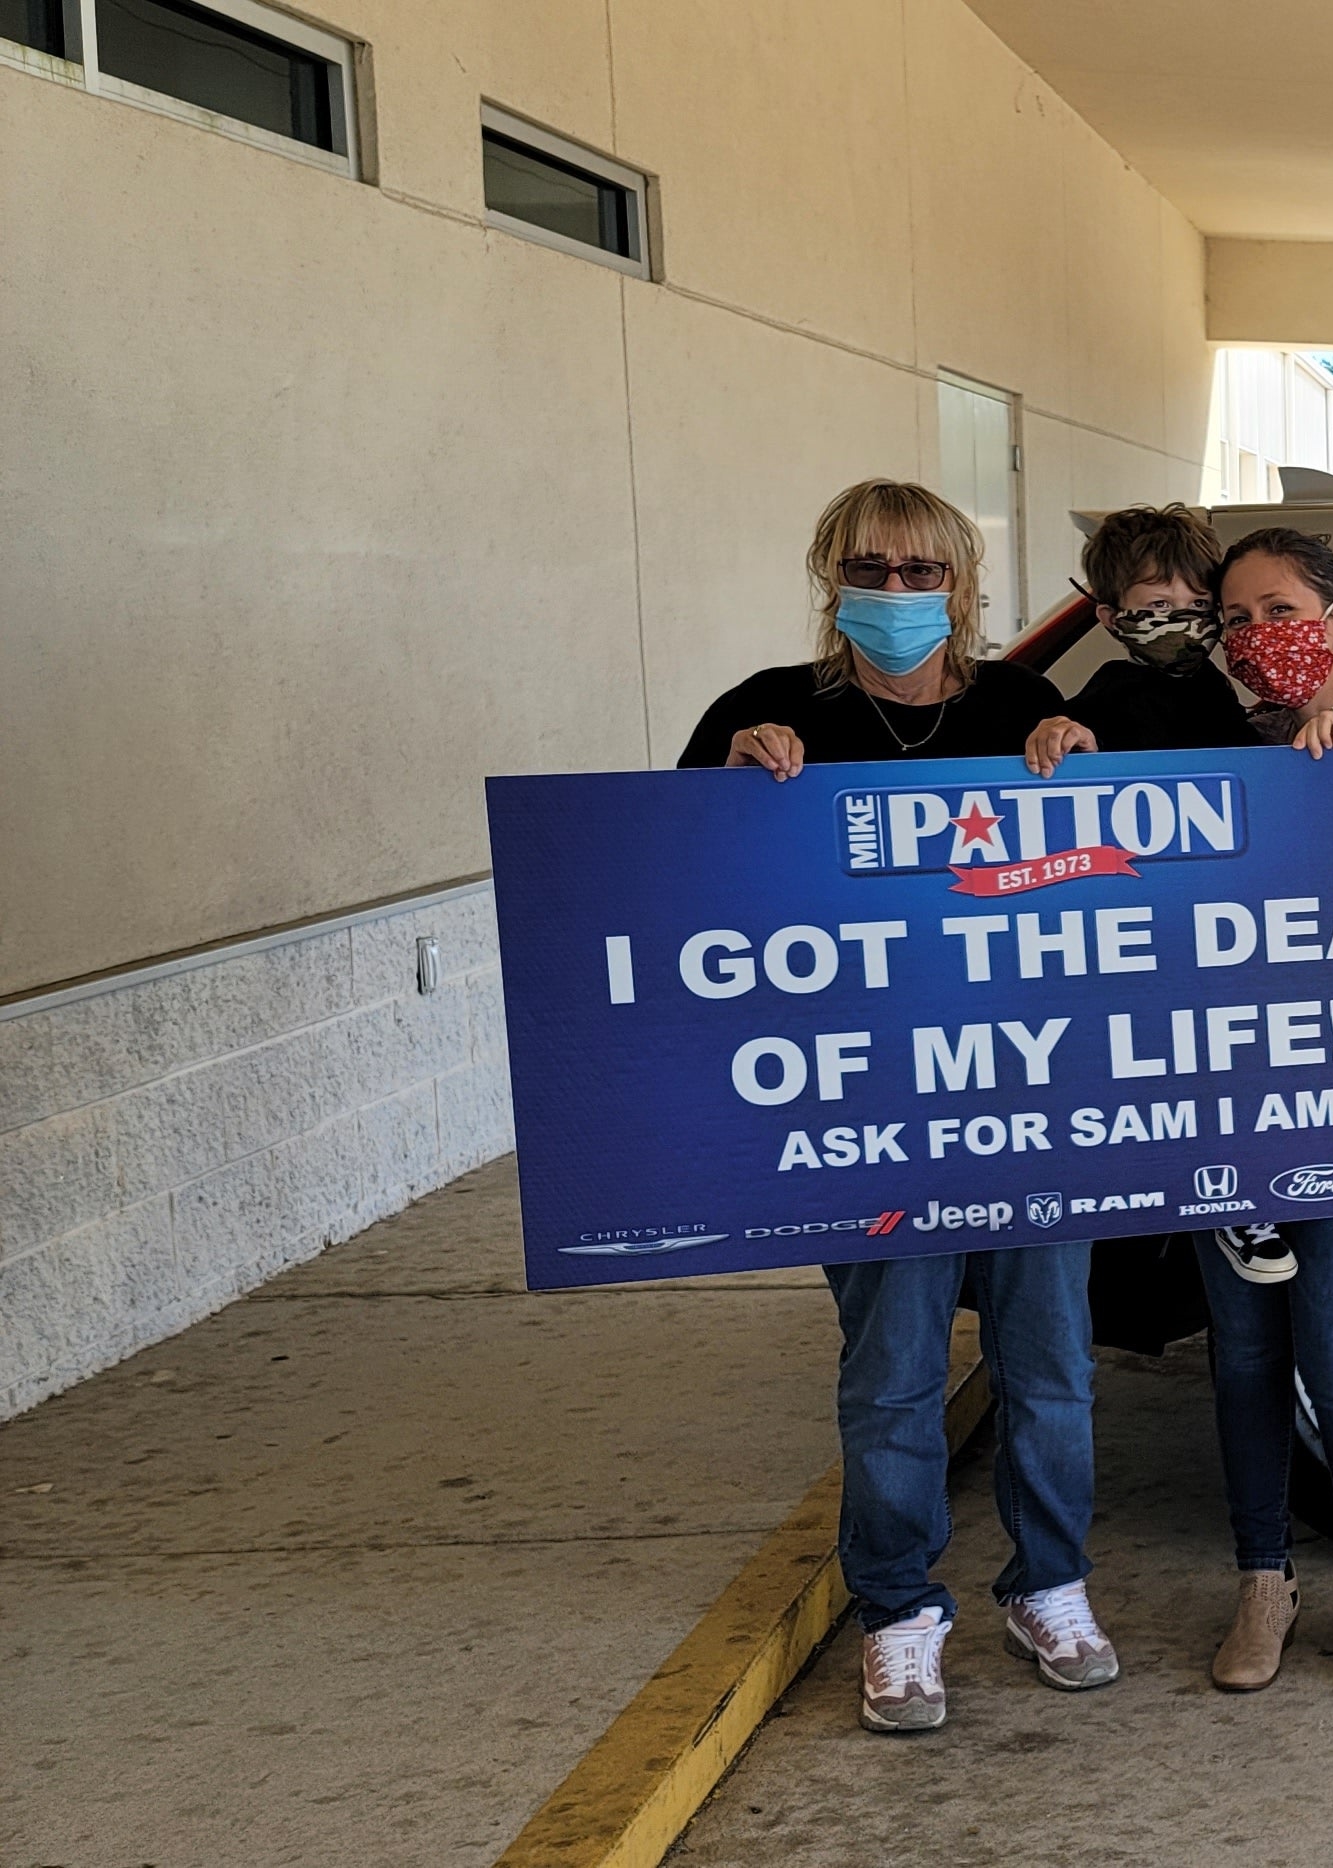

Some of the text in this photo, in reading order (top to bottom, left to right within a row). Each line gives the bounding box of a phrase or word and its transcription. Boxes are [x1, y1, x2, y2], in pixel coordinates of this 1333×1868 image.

[846, 795, 877, 869] MIKE
[887, 780, 1234, 867] PATTON
[998, 854, 1092, 890] EST. 1973
[606, 935, 635, 1004] I
[679, 920, 908, 999] GOT
[943, 906, 1157, 982] THE
[731, 1031, 872, 1106] OF
[913, 1018, 1072, 1094] MY
[777, 1122, 909, 1171] ASK
[929, 1112, 1053, 1159] FOR
[1070, 1100, 1197, 1147] SAM
[1218, 1097, 1234, 1135] I
[913, 1200, 1013, 1231] Jeep
[1070, 1191, 1165, 1214] RAM
[1179, 1199, 1258, 1216] HONDA
[580, 1223, 707, 1242] CHRYSLER
[744, 1217, 885, 1239] DODGE
